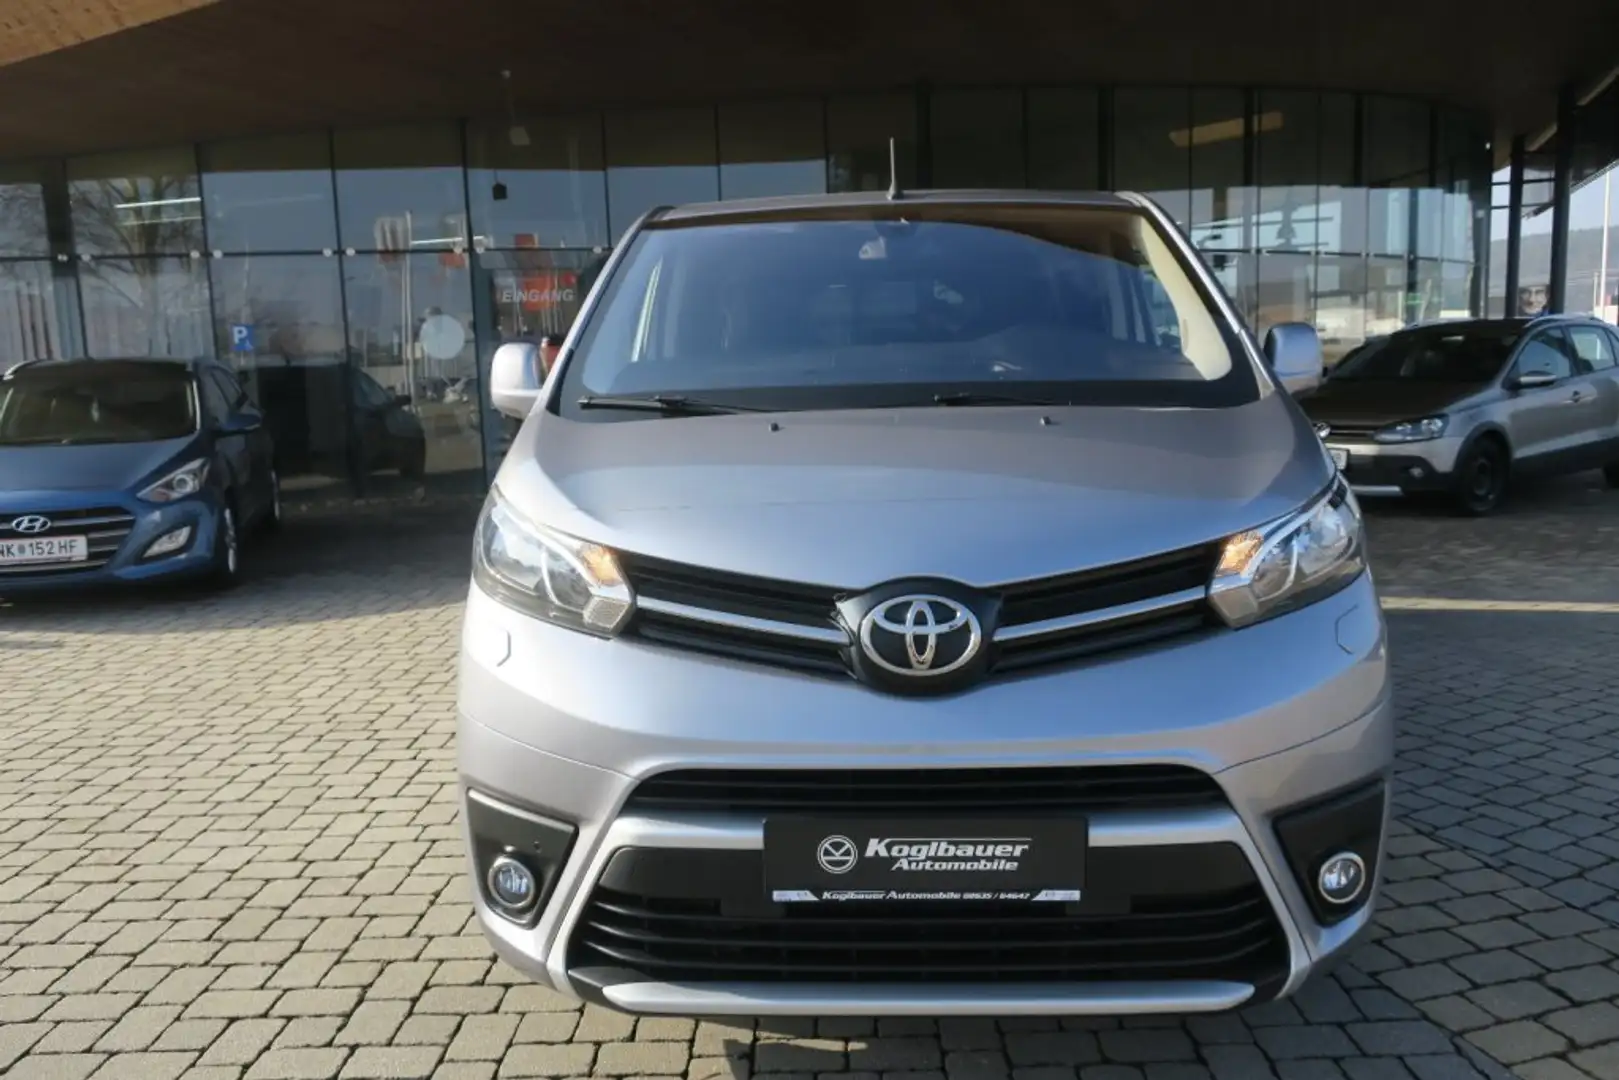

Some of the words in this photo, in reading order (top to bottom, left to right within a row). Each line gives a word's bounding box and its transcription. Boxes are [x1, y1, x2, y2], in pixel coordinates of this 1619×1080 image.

[502, 289, 574, 303] EINGANG
[232, 326, 248, 345] P
[28, 541, 54, 556] 152
[58, 539, 77, 554] HF
[864, 838, 1030, 860] Koglbauer
[890, 858, 1019, 871] Automobile
[822, 890, 885, 901] Koglbauer
[886, 890, 961, 900] Automobile
